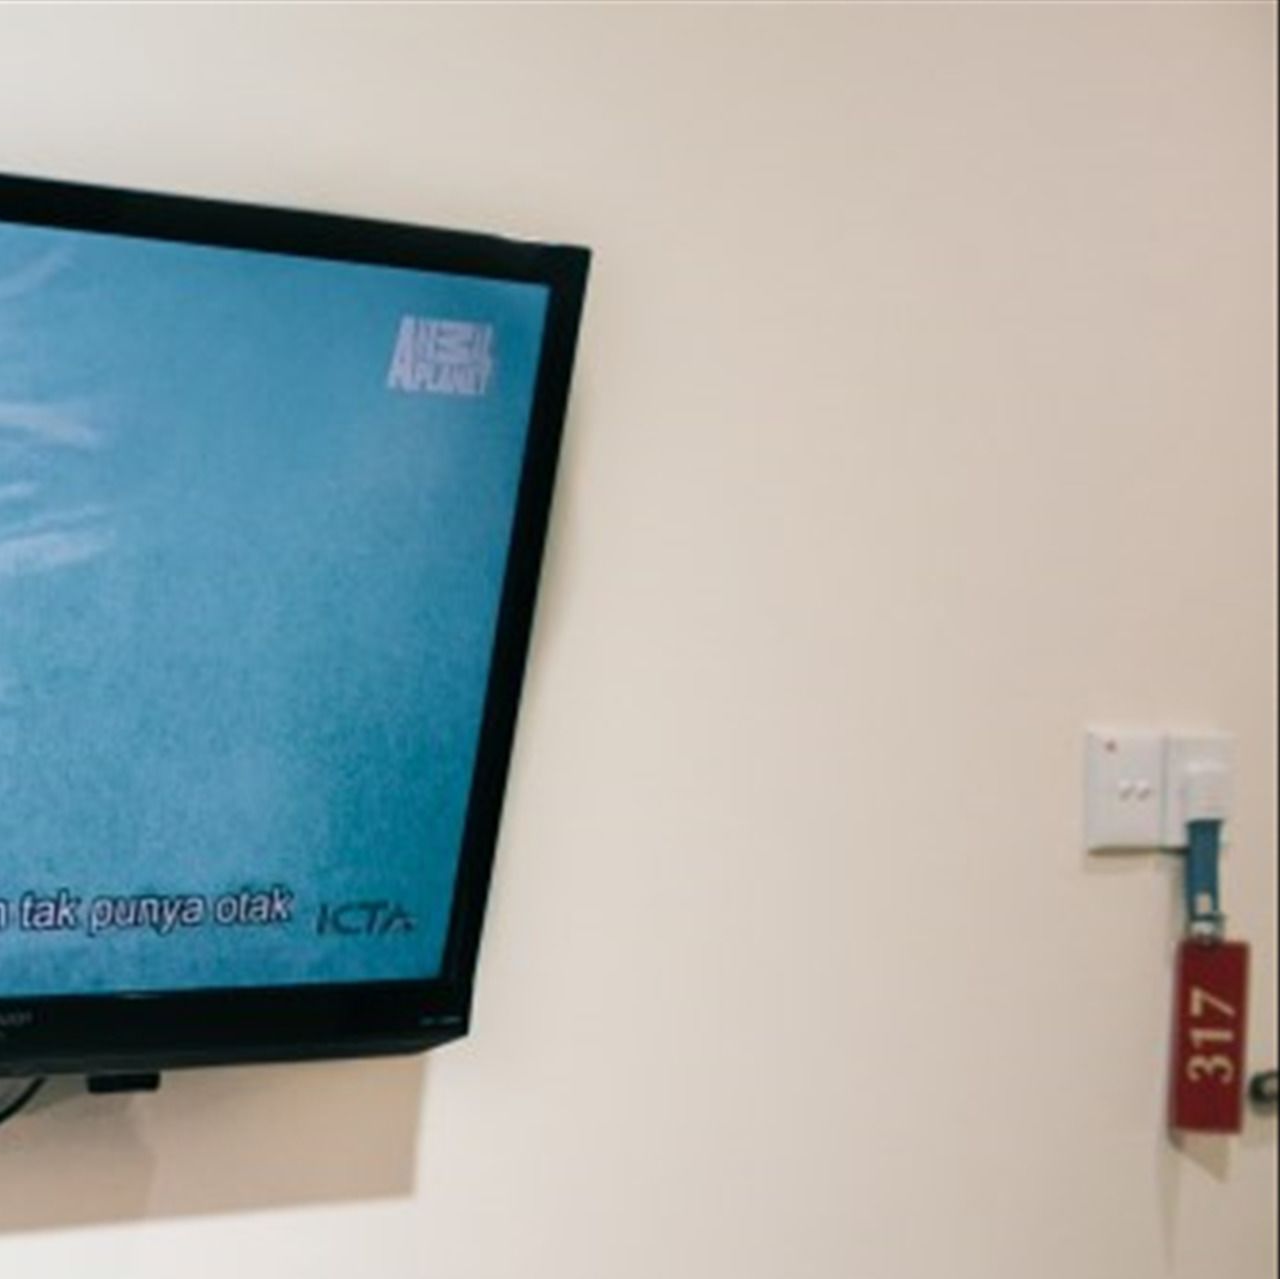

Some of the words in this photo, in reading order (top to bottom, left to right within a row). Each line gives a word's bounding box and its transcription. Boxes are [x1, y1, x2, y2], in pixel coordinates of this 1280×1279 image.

[19, 888, 78, 931] tak
[89, 893, 203, 937] punya
[214, 884, 294, 925] otak
[1186, 986, 1237, 1084] 317
